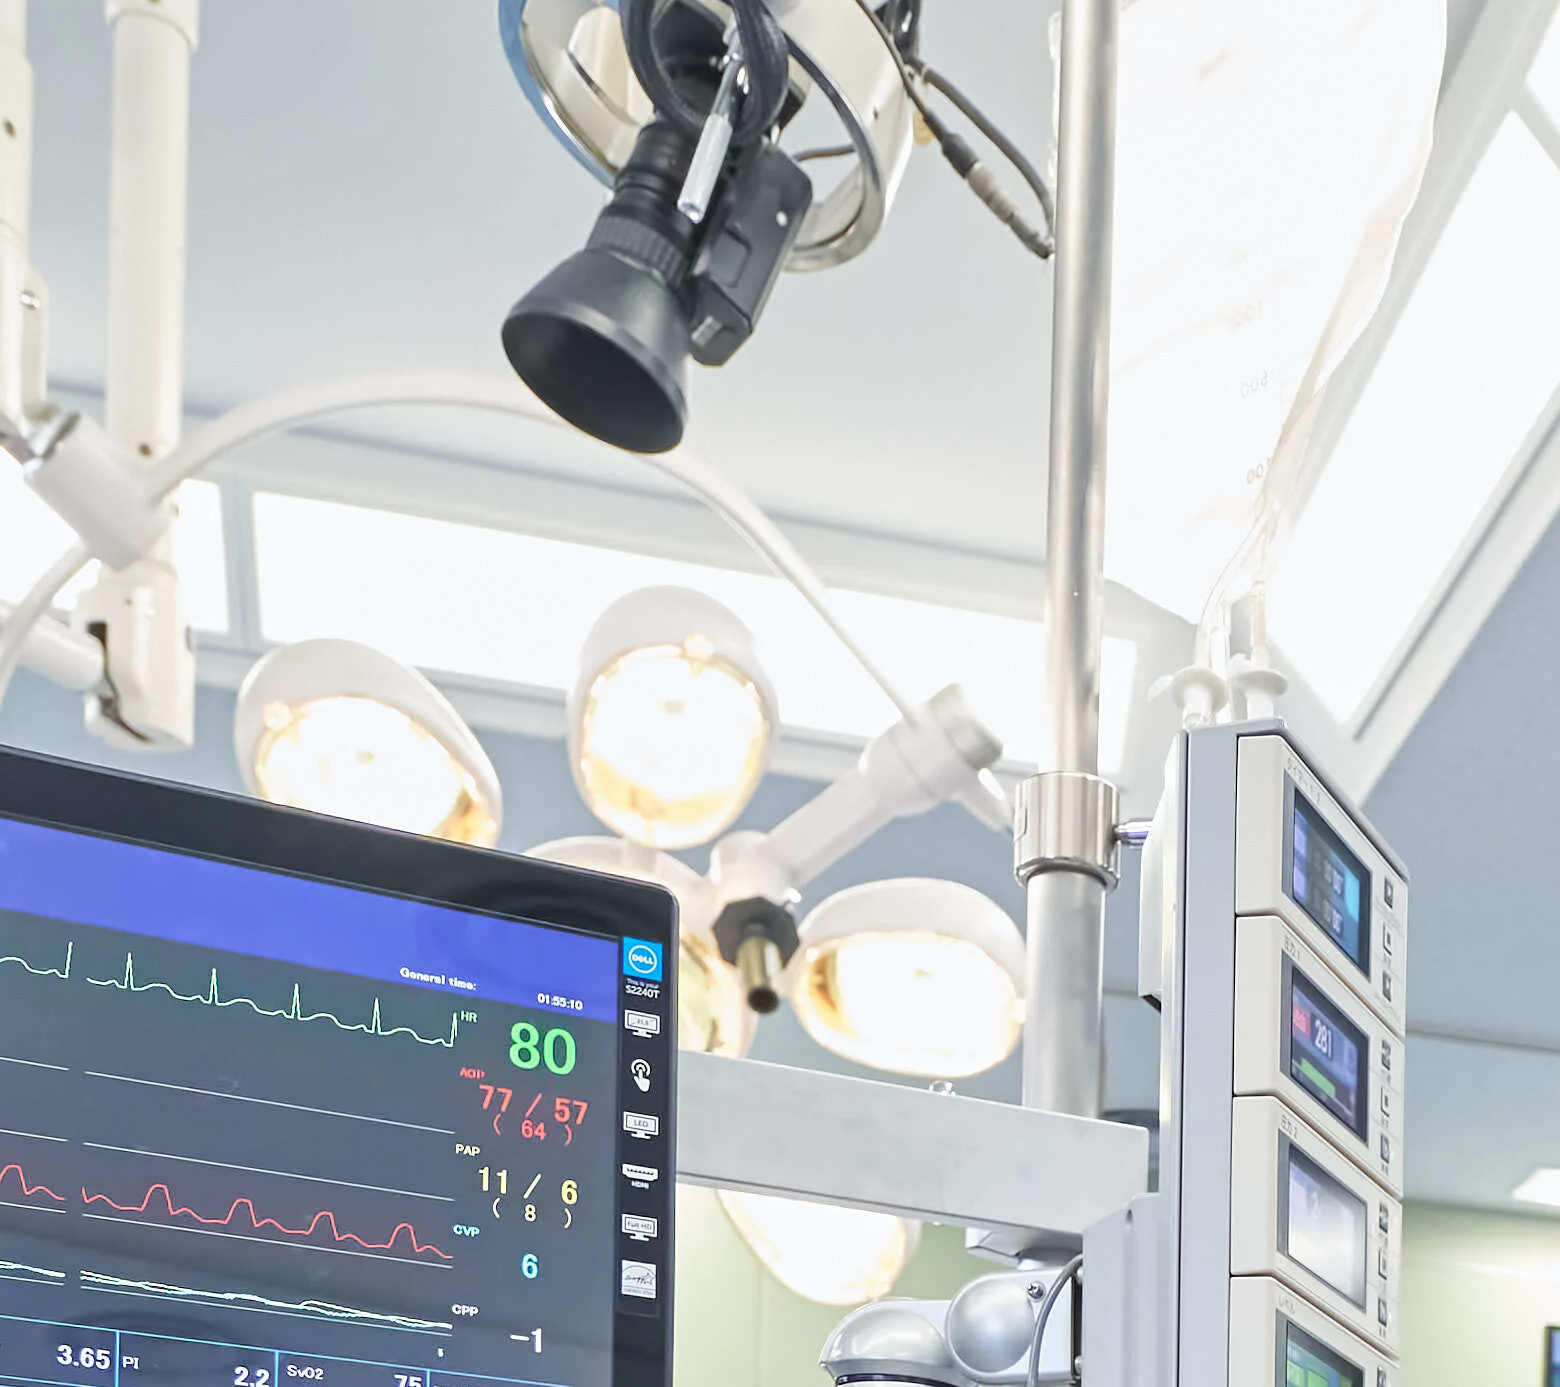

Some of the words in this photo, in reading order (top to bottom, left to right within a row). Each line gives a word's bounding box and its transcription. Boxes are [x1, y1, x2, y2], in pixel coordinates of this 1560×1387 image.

[400, 967, 446, 986] General
[448, 977, 477, 991] time:
[537, 993, 584, 1011] 01:55:10
[625, 985, 661, 999] S2240T
[460, 1011, 478, 1024] HR
[1314, 1018, 1332, 1058] 281
[509, 1021, 577, 1076] 80
[479, 1084, 513, 1113] 77
[554, 1097, 589, 1125] 57
[521, 1120, 546, 1141] 64
[455, 1143, 481, 1157] PAP
[478, 1166, 508, 1195] 11
[561, 1179, 579, 1206] 6
[524, 1203, 537, 1223] 8
[453, 1223, 481, 1238] CVP
[521, 1253, 539, 1279] 6
[452, 1303, 480, 1317] CPP
[56, 1344, 111, 1371] 3.65
[121, 1355, 140, 1370] PI
